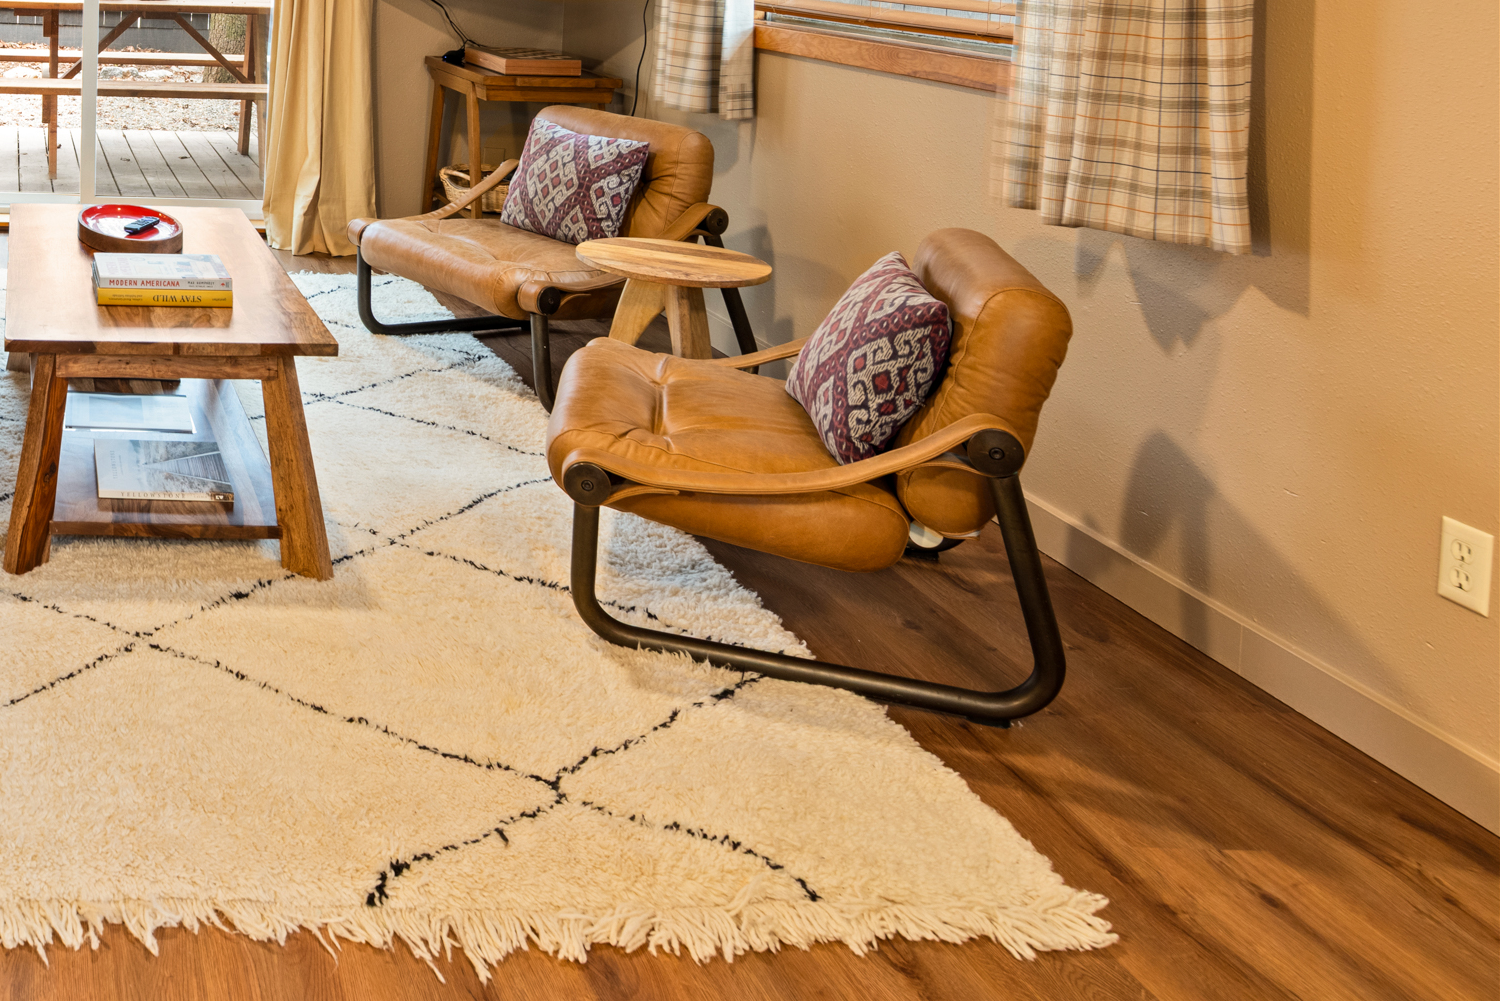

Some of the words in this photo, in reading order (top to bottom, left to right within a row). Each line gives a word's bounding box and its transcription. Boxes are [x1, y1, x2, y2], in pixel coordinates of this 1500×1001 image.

[152, 294, 178, 303] WILD
[179, 295, 202, 303] STAY
[120, 491, 186, 499] YELLOWSTONE
